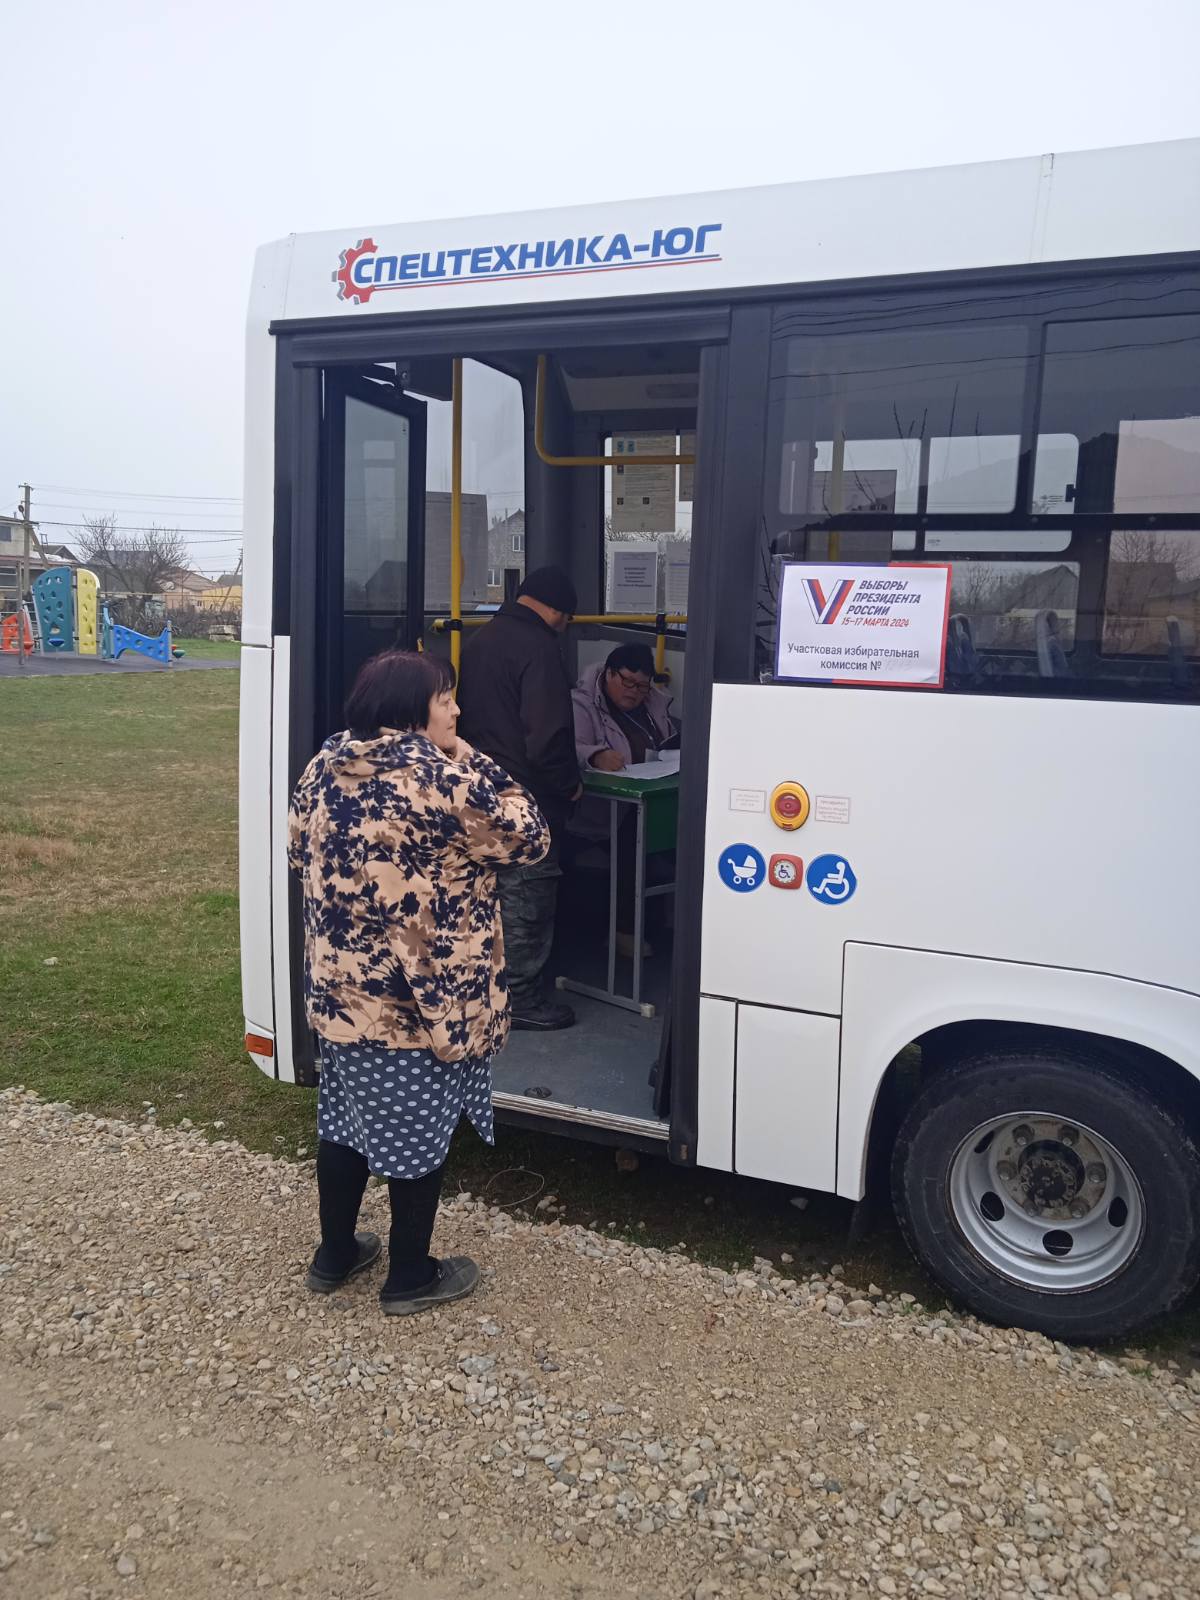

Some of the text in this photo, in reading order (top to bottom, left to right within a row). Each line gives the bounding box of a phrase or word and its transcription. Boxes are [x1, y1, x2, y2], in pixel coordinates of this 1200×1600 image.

[354, 223, 722, 284] СПЕЦТЕХНИКА-ЮГ
[859, 580, 908, 590] ВЫБОРЫ
[852, 593, 921, 604] ПРЕЗИДЕНТА
[846, 605, 890, 615] РОССИИ
[863, 618, 889, 627] МАРТА
[890, 618, 910, 628] 2024
[787, 643, 919, 659] Участковая избирательная
[820, 660, 867, 671] комиссия
[870, 660, 882, 671] №
